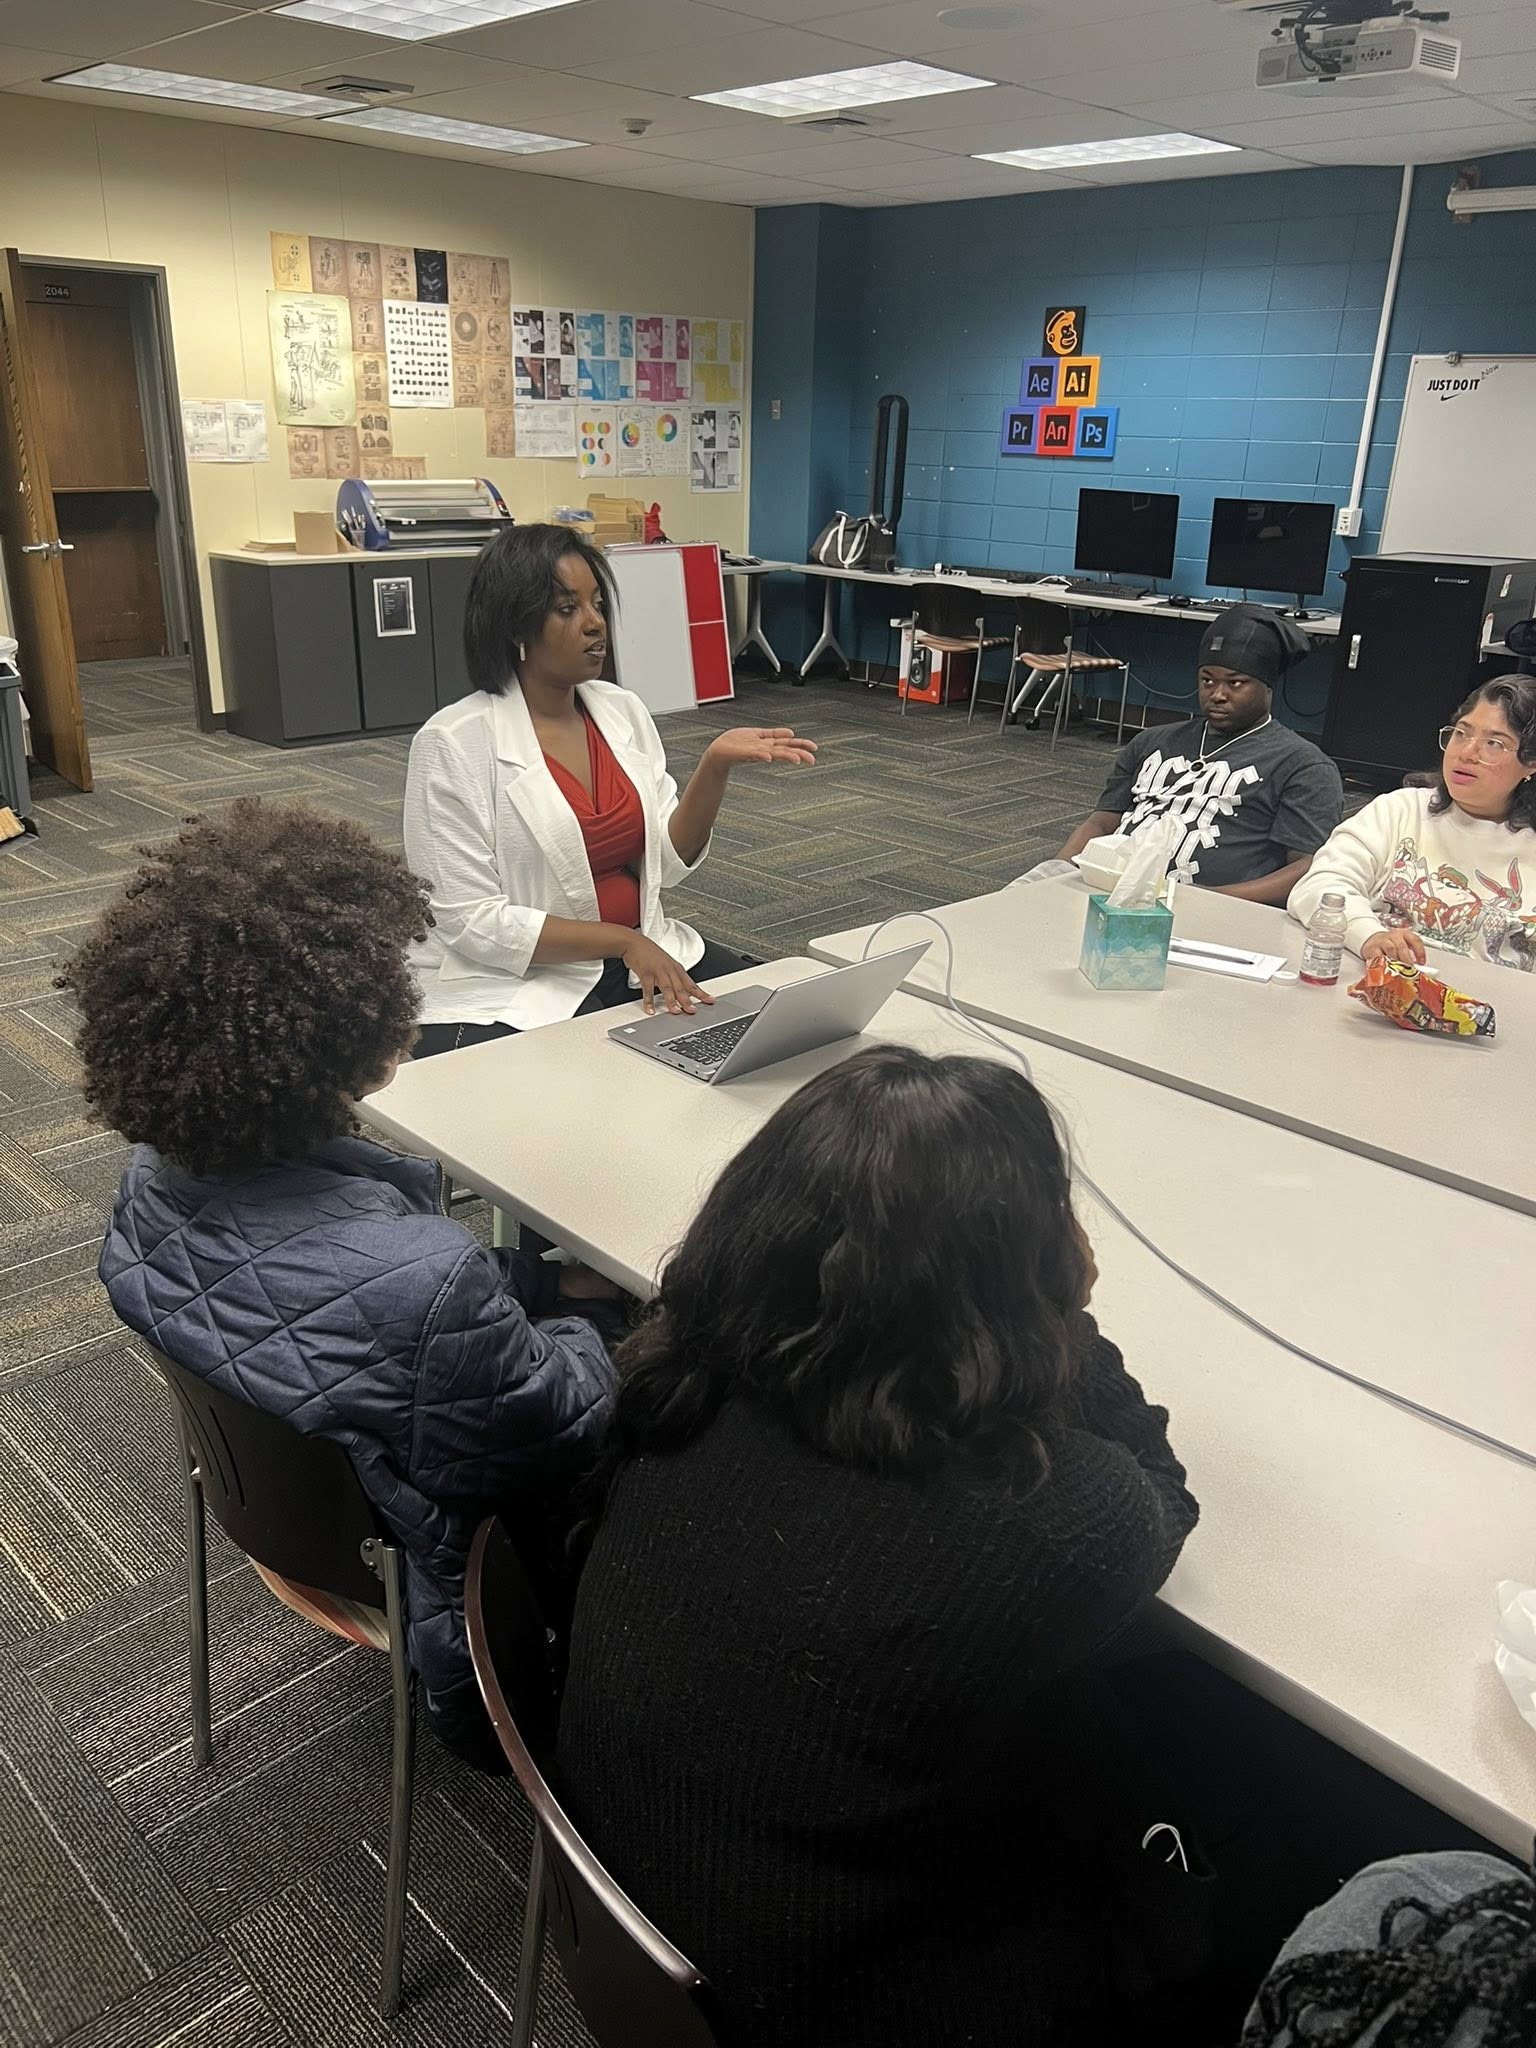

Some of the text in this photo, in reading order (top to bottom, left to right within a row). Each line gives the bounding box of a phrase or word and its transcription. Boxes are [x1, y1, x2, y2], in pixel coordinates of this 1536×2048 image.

[45, 286, 69, 296] 2044
[1029, 373, 1049, 393] Ae
[1066, 372, 1086, 392] Ai
[1427, 379, 1480, 391] JUST DO IT
[1012, 421, 1028, 440] Pr
[1046, 421, 1066, 440] An
[1085, 423, 1102, 443] Ps
